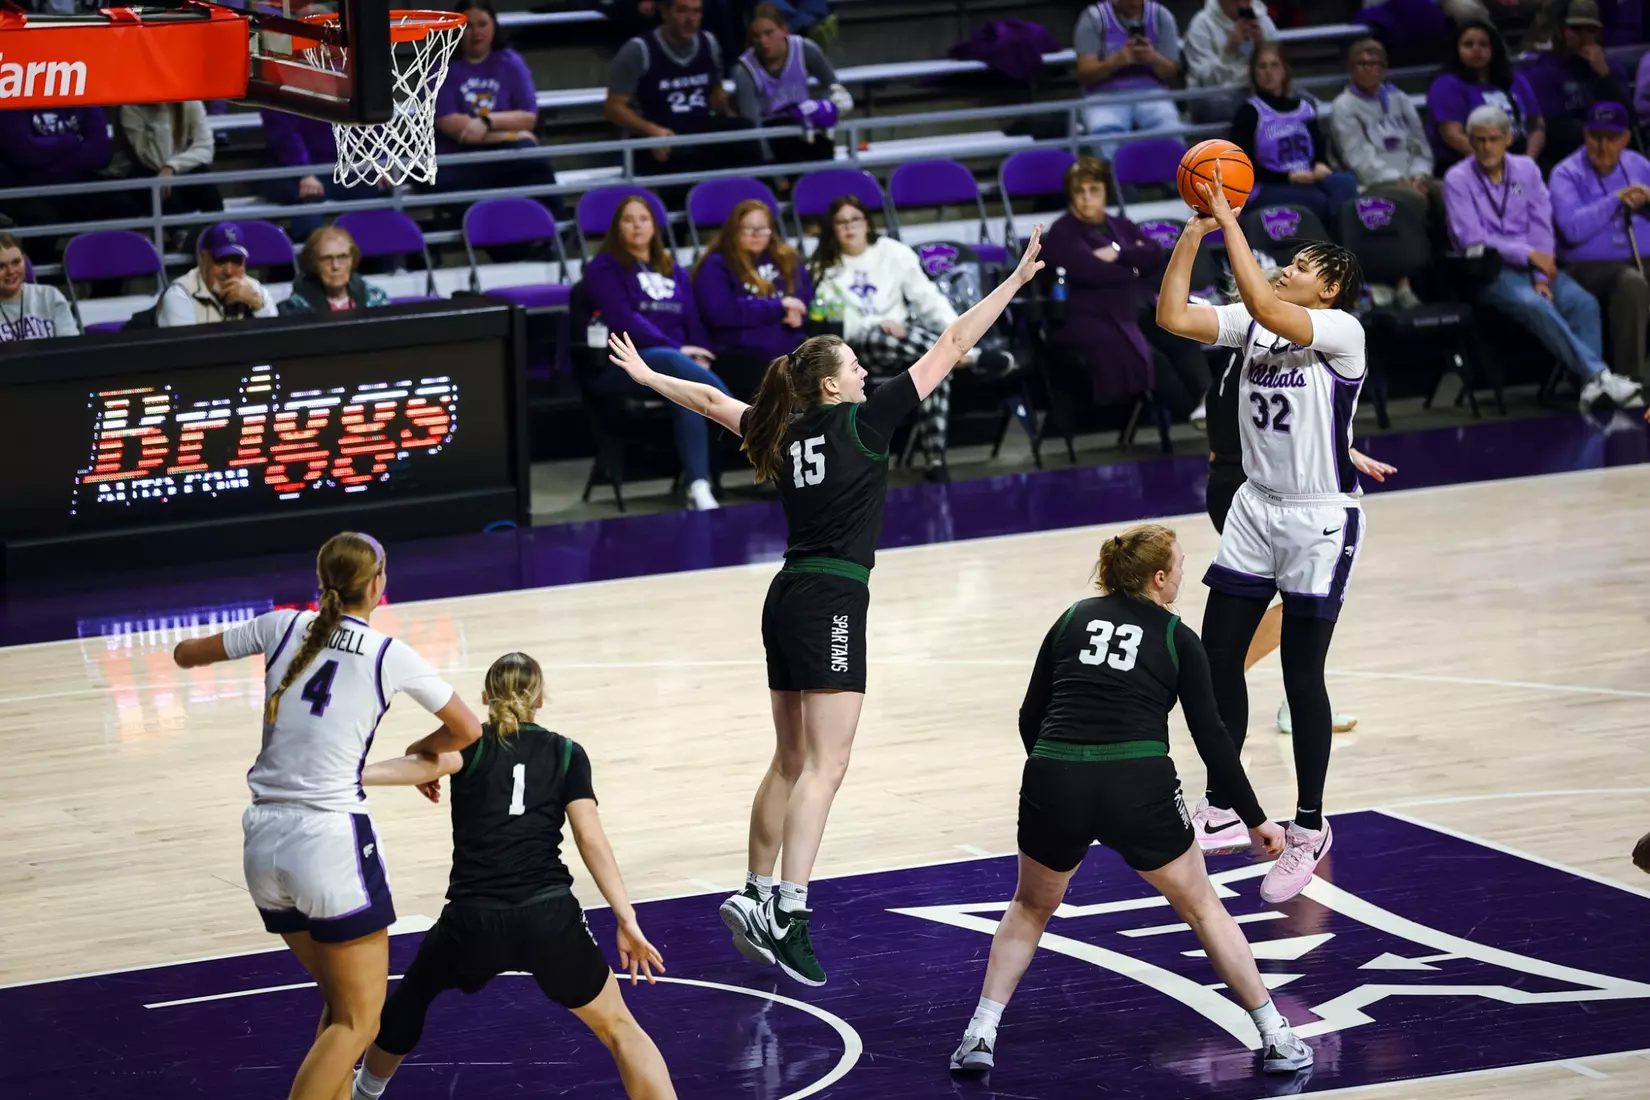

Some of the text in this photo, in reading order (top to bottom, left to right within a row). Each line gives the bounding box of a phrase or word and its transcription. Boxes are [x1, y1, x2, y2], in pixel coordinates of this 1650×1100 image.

[0, 52, 87, 99] arm
[80, 366, 456, 500] Briggs
[1249, 391, 1292, 434] 32
[789, 434, 826, 488] 15
[831, 614, 848, 673] SPARTANS
[1079, 619, 1143, 672] 33
[301, 659, 339, 718] 4
[508, 763, 526, 816] 1
